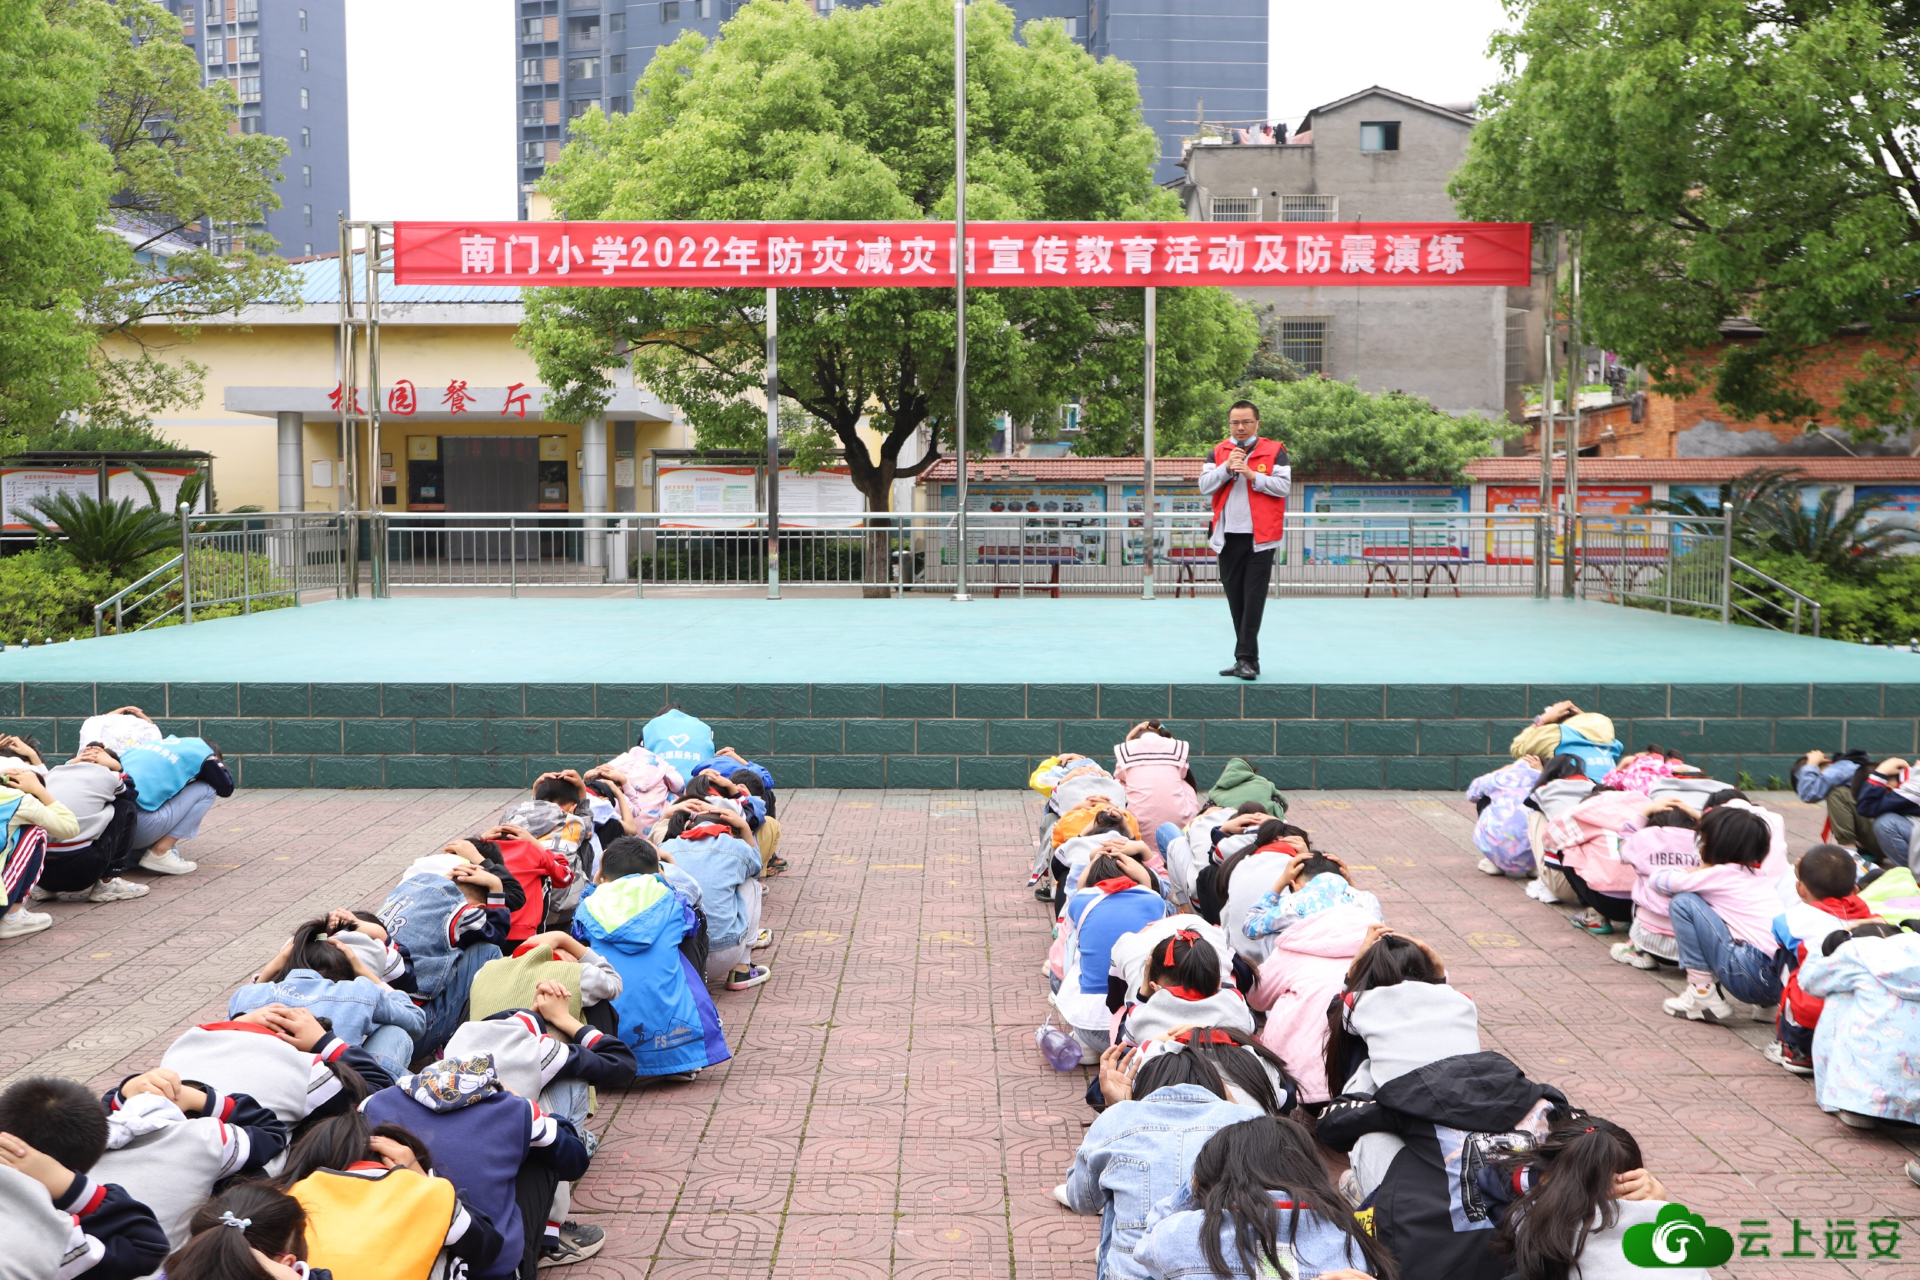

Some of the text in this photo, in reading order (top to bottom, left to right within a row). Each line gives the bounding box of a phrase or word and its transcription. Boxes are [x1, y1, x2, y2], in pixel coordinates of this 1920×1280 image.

[459, 234, 1466, 275] 南门小学2022年防灾减灾日宣传教育活动及防震演练
[328, 379, 532, 418] 校园餐厅
